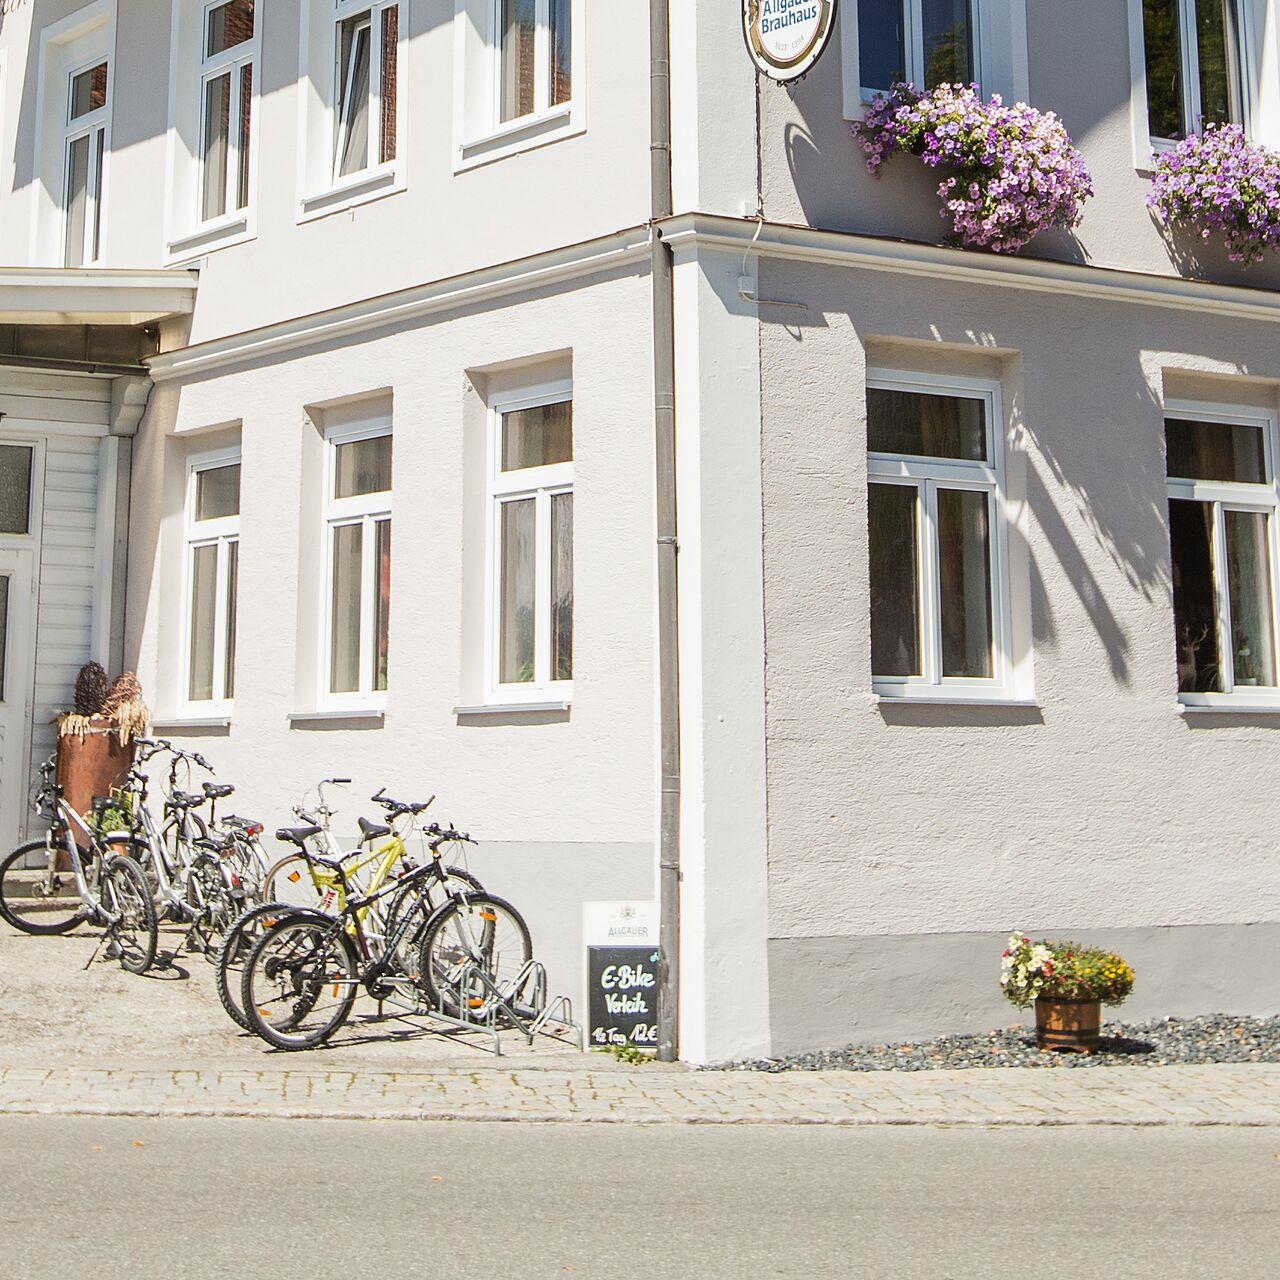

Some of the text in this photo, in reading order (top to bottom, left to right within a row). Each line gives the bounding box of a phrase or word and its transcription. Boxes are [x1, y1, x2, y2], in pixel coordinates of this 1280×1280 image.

[762, 5, 817, 35] Brauhaus
[601, 964, 656, 989] E-Bike
[604, 992, 649, 1014] Verleih
[606, 1027, 627, 1046] Tag
